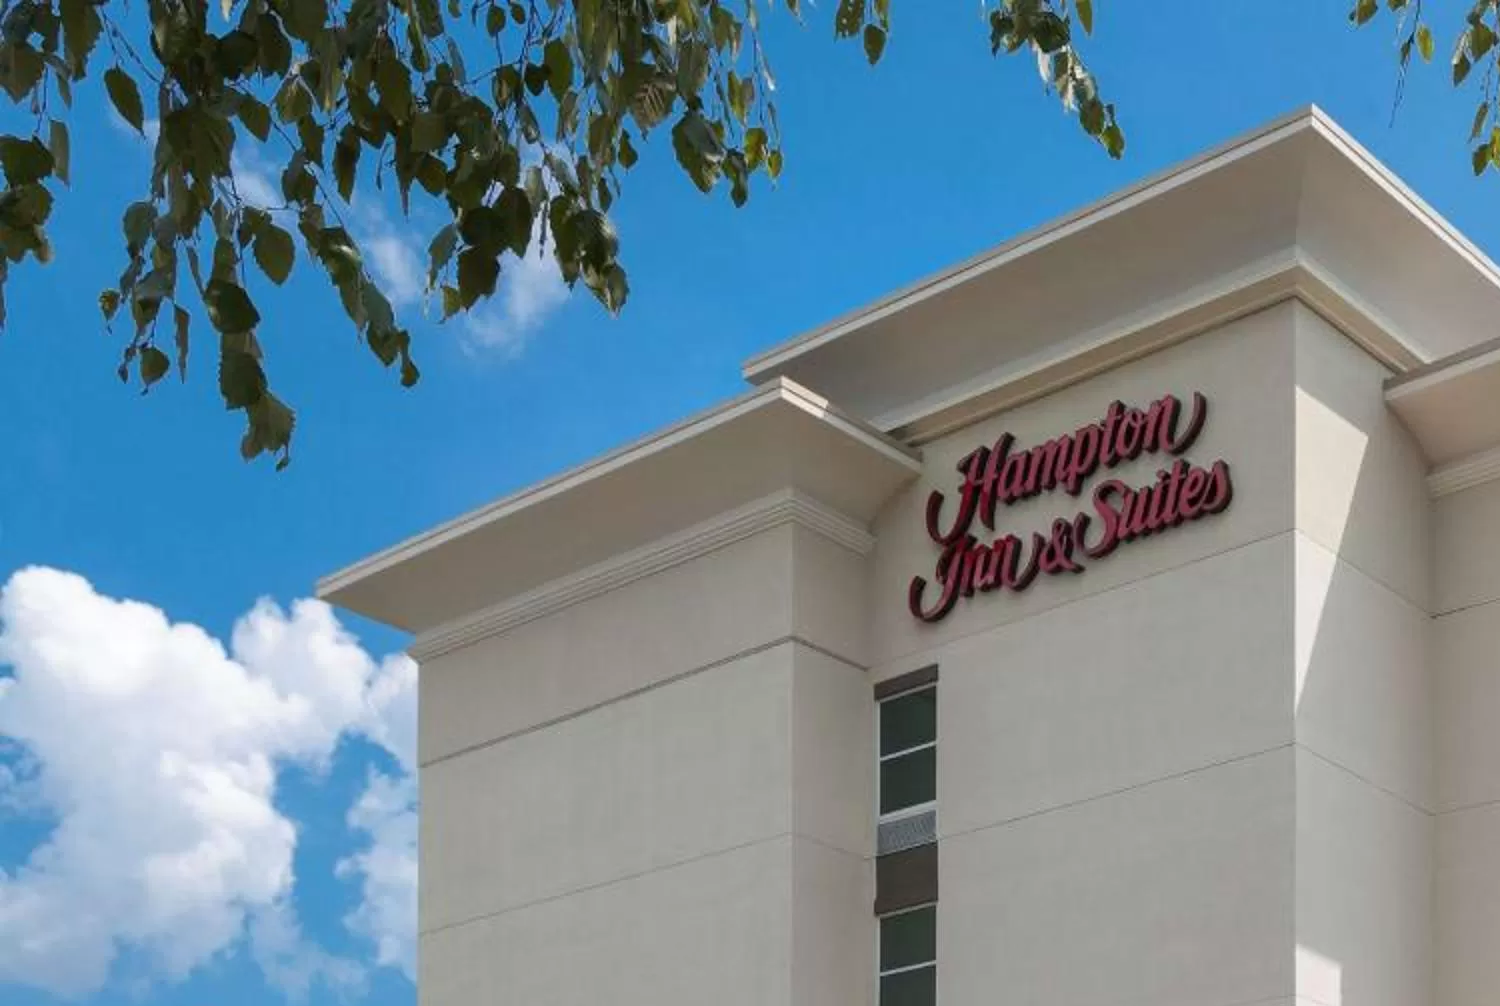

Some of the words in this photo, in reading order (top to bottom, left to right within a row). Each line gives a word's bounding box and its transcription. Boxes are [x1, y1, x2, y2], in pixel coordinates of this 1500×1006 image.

[908, 534, 1046, 622] Inn
[1039, 518, 1086, 574] &
[1073, 459, 1234, 559] Suites
[927, 391, 1207, 544] Hampton
